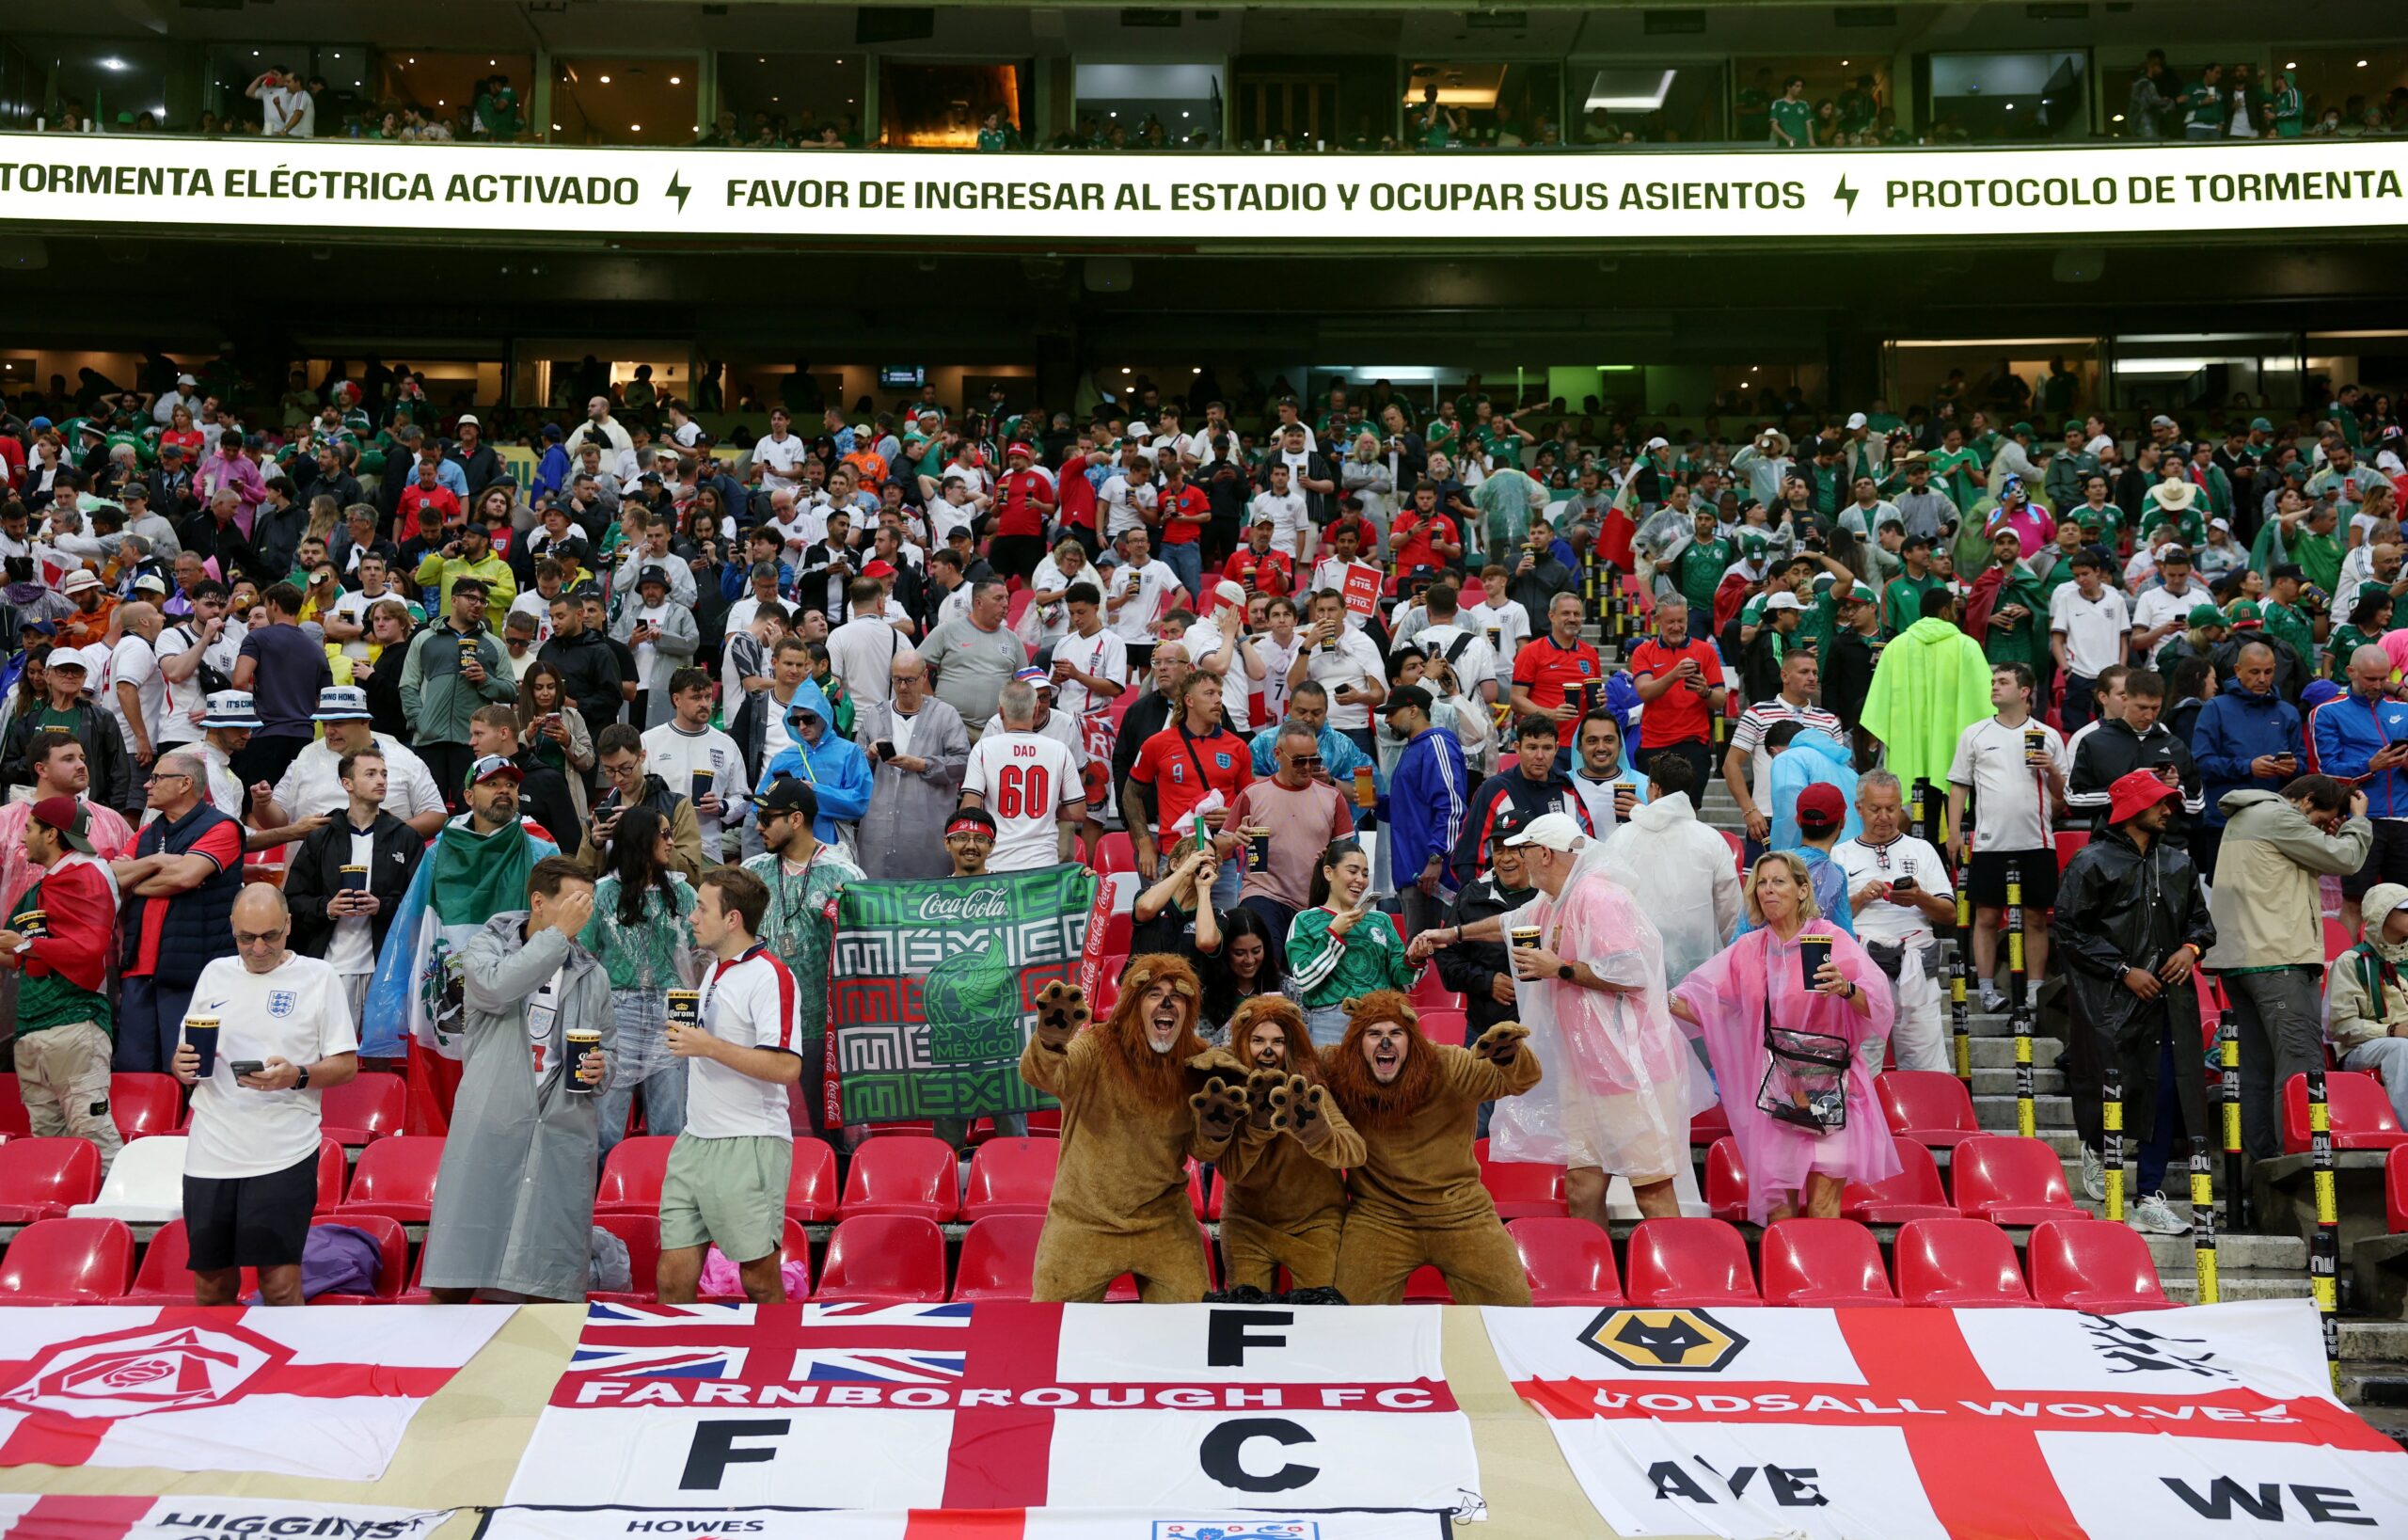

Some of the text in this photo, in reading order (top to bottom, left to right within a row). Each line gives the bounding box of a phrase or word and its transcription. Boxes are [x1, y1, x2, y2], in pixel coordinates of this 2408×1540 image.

[0, 163, 2403, 212] TORMENTA ELÉCTRICA ACTIVADO FAVOR DE INGRESAR AL ESTADIO Y OCUPAR SUS ASIENTOS PROTOCOLO DE TORMENTA
[338, 692, 356, 702] HOME
[1275, 683, 1285, 701] 7
[1013, 744, 1037, 757] DAD
[1172, 763, 1183, 784] 9
[998, 764, 1049, 819] 60
[918, 887, 1009, 921] Coca-Cola
[669, 1008, 695, 1019] Corona
[531, 1044, 547, 1072] 7
[934, 1035, 1015, 1059] MÉXICO
[2103, 1135, 2116, 1166] 117
[2193, 1210, 2208, 1245] 117
[2195, 1250, 2207, 1303] SECCIÓN
[1208, 1309, 1294, 1368] F
[575, 1381, 1434, 1409] FARNBOROUGH FC
[1956, 1399, 2304, 1424] WOLVES
[678, 1417, 1321, 1494] F C
[2158, 1474, 2380, 1527] WE
[155, 1512, 406, 1539] HIGGINS
[626, 1519, 766, 1533] HOWES
